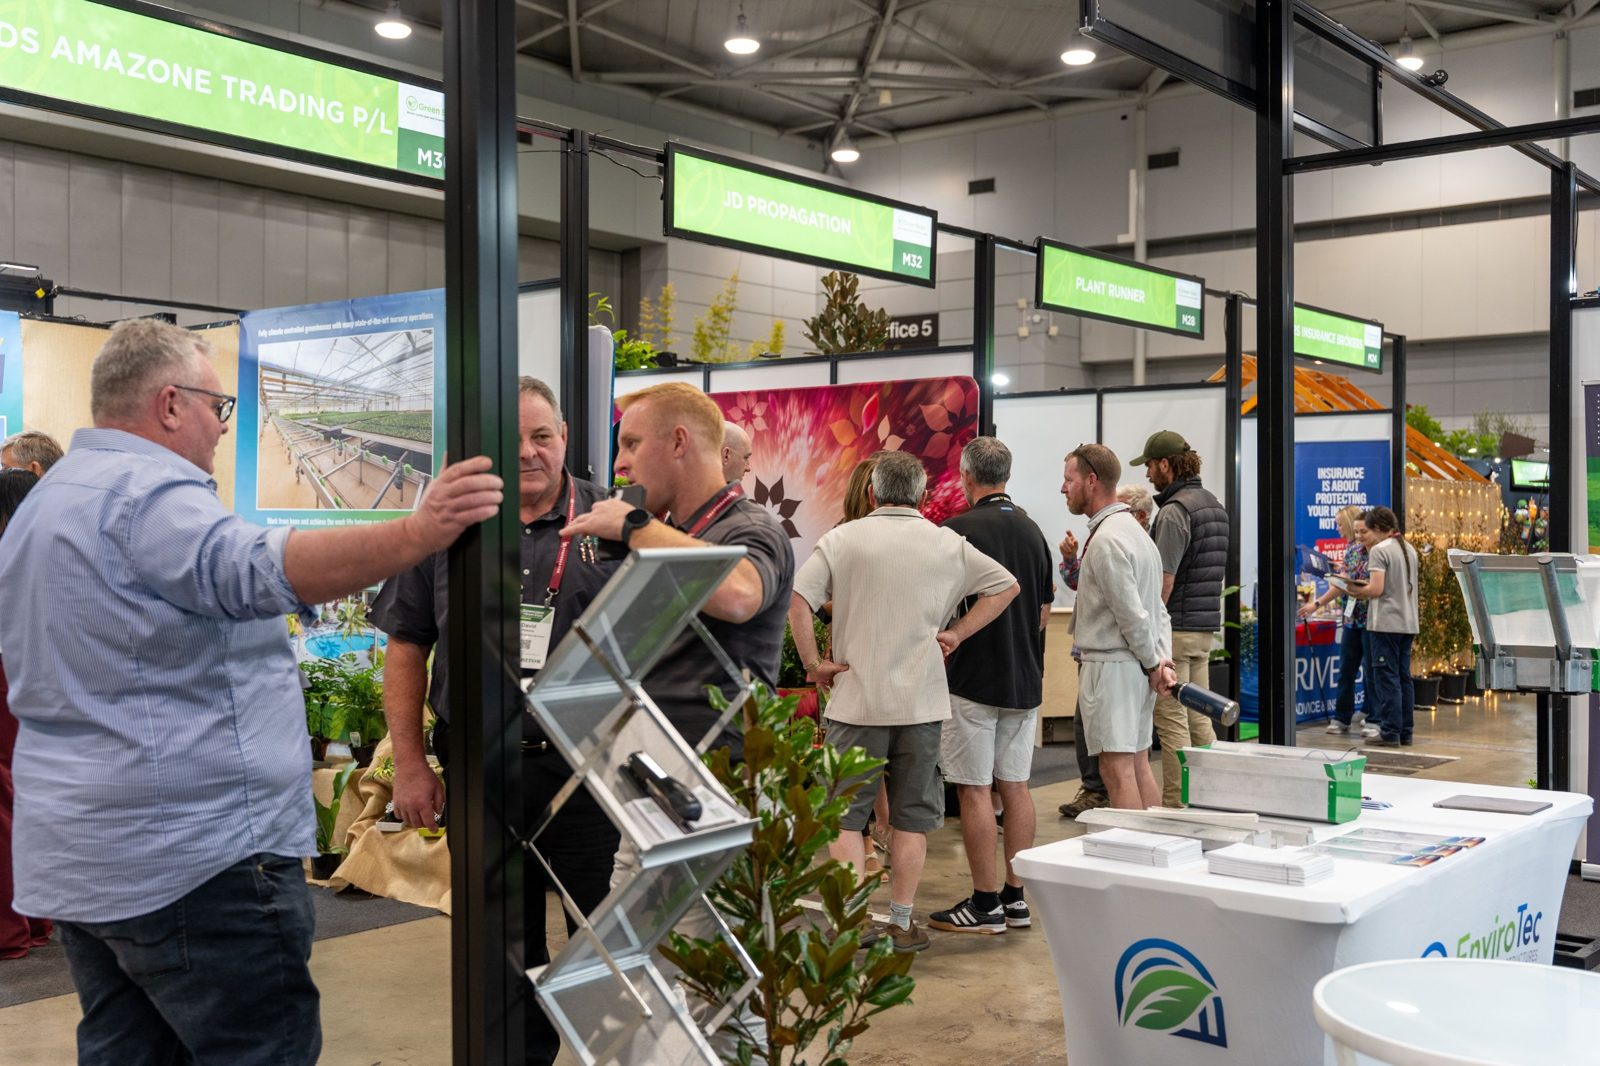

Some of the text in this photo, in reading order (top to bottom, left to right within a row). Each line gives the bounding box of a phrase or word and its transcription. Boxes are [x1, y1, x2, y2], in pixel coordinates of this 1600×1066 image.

[50, 34, 211, 95] AMAZONE
[221, 74, 345, 125] TRADING
[353, 107, 393, 136] P/L
[417, 147, 445, 169] M3
[723, 191, 851, 234] JD PROPAGATION
[902, 252, 923, 269] M32
[1075, 276, 1146, 303] PLANT RUNNER
[888, 319, 933, 338] fice 5
[1317, 467, 1365, 480] INSURANCE
[1321, 480, 1360, 492] IS ABOUT
[1315, 492, 1367, 505] PROTECTING
[1307, 505, 1330, 517] YOUR
[1318, 518, 1335, 530] NOT
